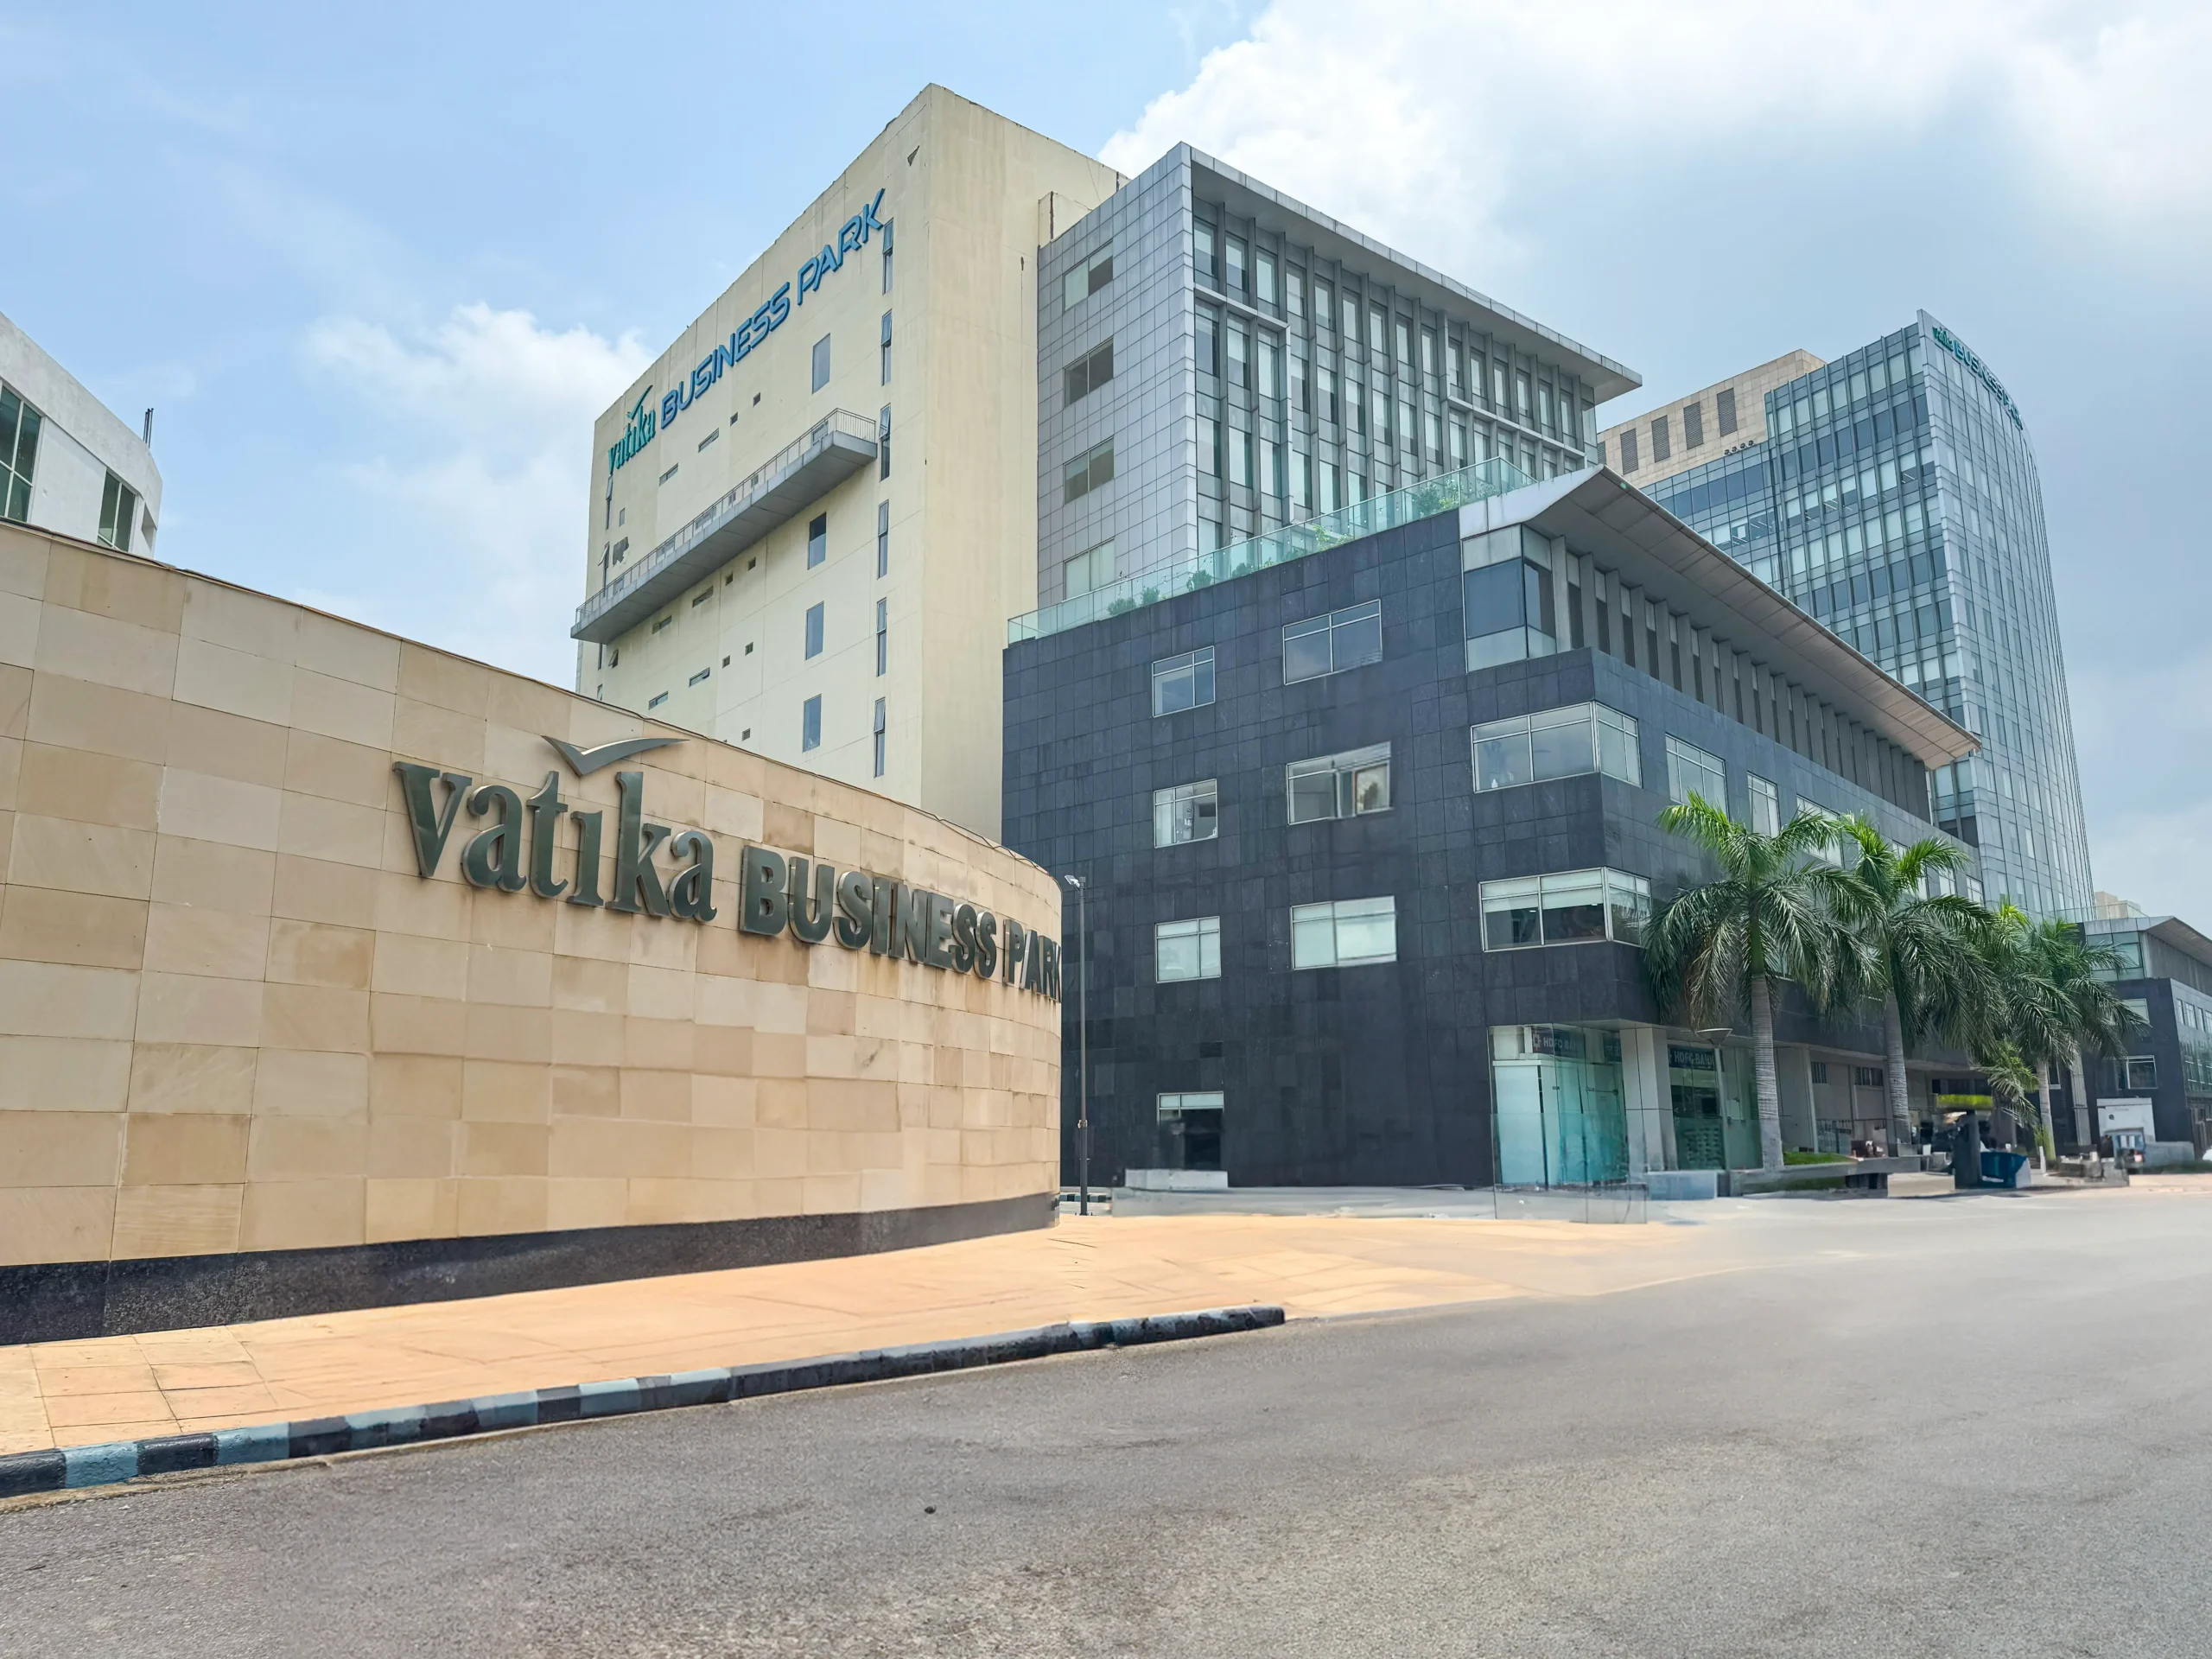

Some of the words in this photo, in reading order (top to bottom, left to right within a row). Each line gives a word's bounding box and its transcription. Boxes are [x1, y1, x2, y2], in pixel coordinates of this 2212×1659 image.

[607, 401, 657, 475] vatika
[661, 282, 791, 429] BUSINESS
[797, 188, 887, 306] PARK
[392, 759, 718, 923] vatika
[739, 844, 997, 980] BUSINESS
[1002, 918, 1062, 1003] PARK
[1543, 1036, 1563, 1050] HDFC
[1674, 1050, 1694, 1065] HDFC
